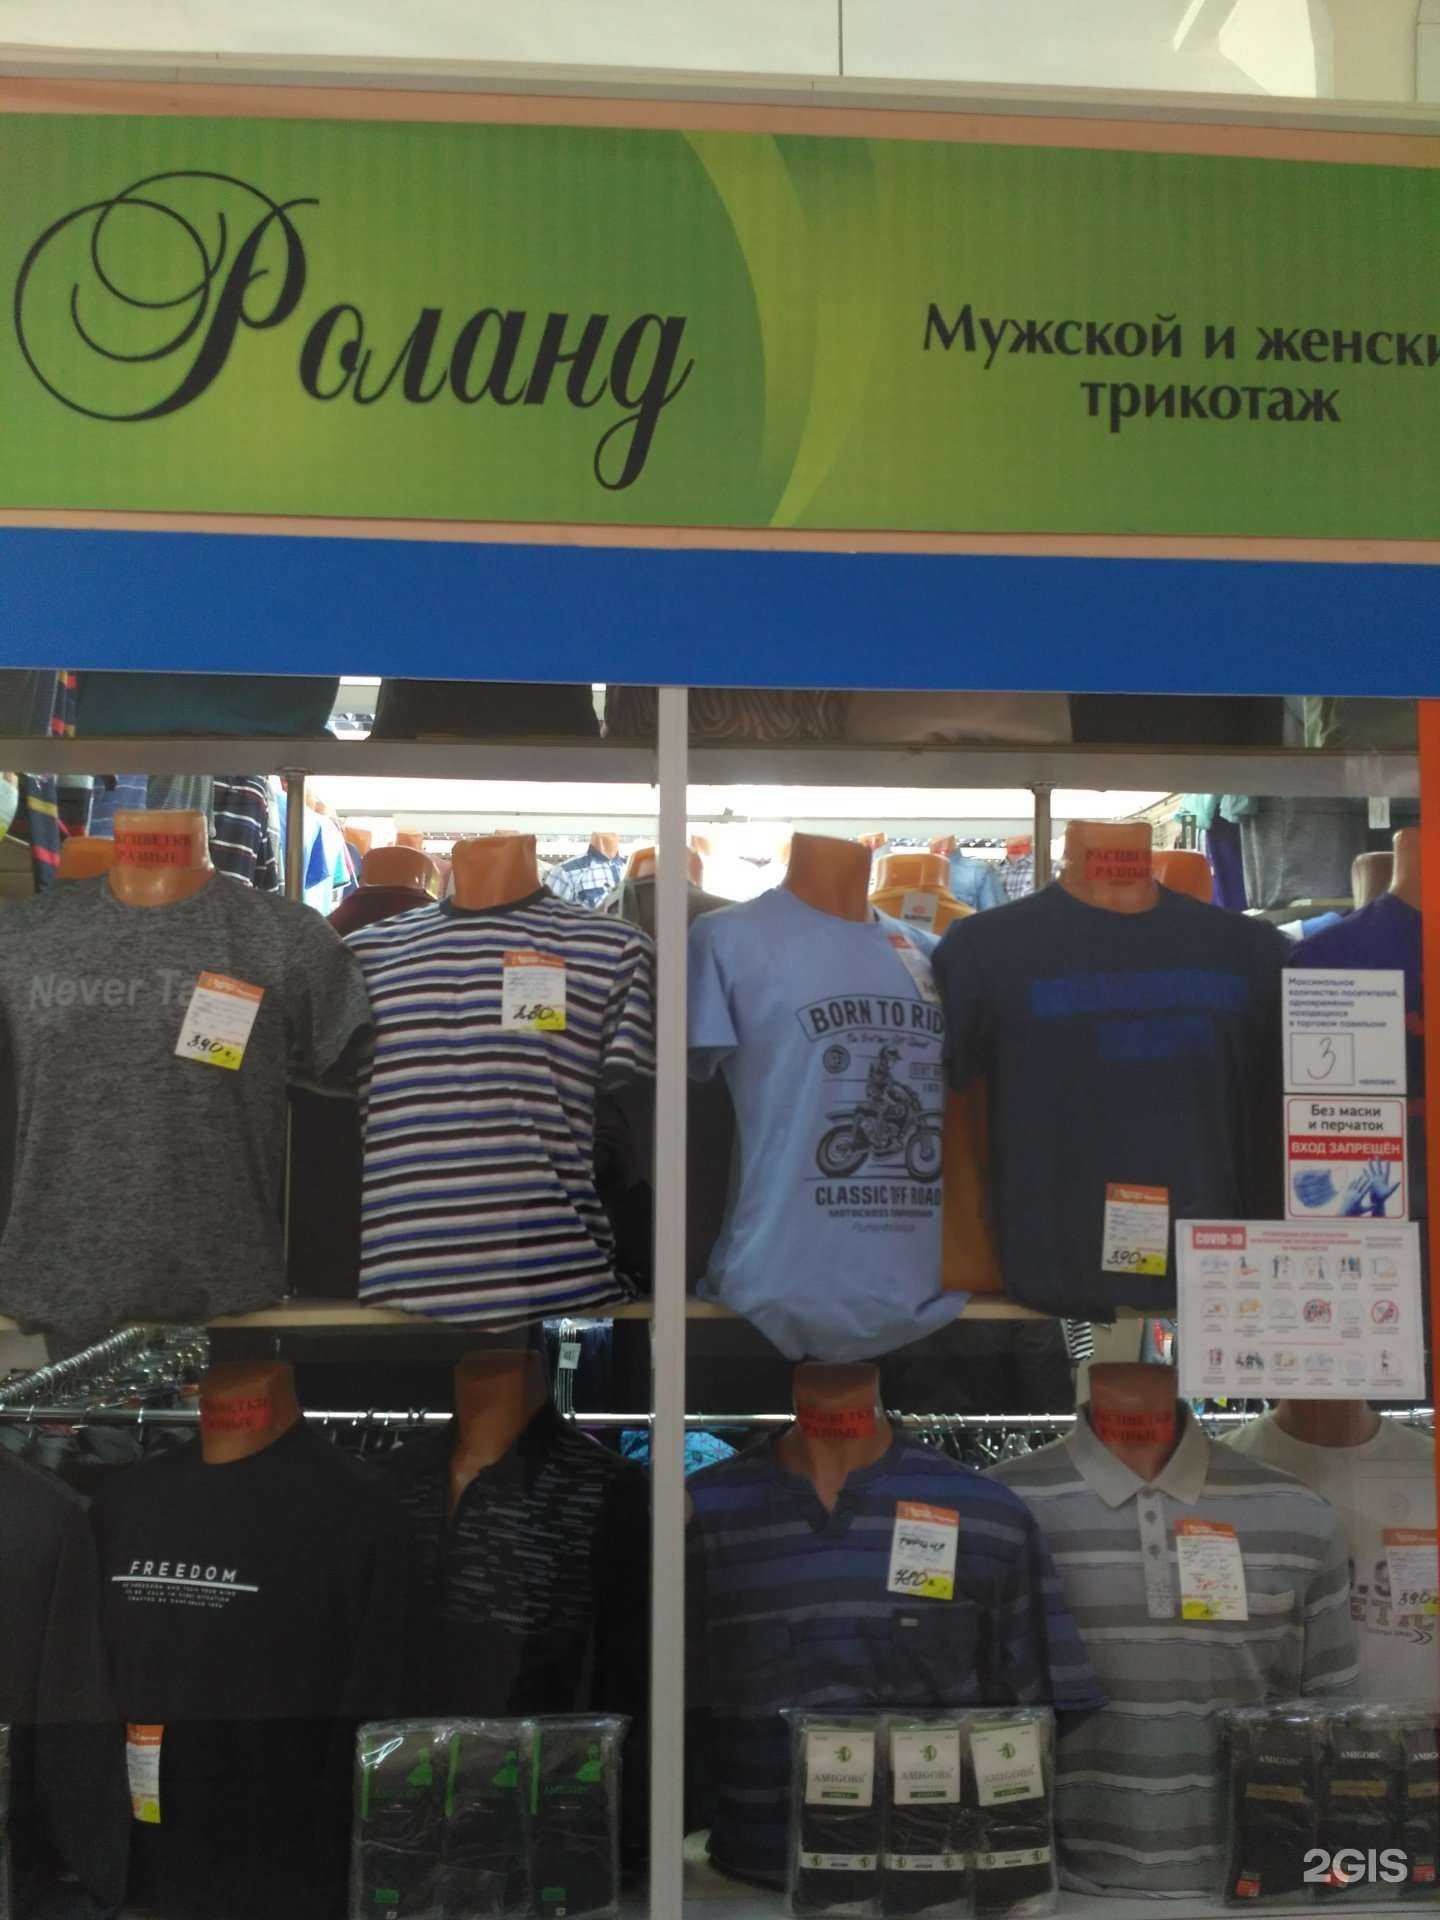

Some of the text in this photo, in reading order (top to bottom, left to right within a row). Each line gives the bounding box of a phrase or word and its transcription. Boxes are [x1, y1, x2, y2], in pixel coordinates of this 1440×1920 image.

[14, 170, 694, 490] Роланд
[922, 302, 1183, 370] Мужской
[1204, 325, 1236, 359] и
[1080, 381, 1342, 433] трикотаж
[29, 973, 145, 1009] Never
[809, 998, 872, 1034] BORN
[876, 1001, 902, 1026] TO
[1306, 1036, 1337, 1080] 3
[1311, 1104, 1382, 1117] Без маски
[1308, 1121, 1384, 1132] и перчаток
[1291, 1142, 1327, 1155] ВХОД
[815, 1185, 889, 1207] CLASSIC
[1195, 1232, 1244, 1245] COVID-19
[129, 1560, 237, 1583] FREEDOM
